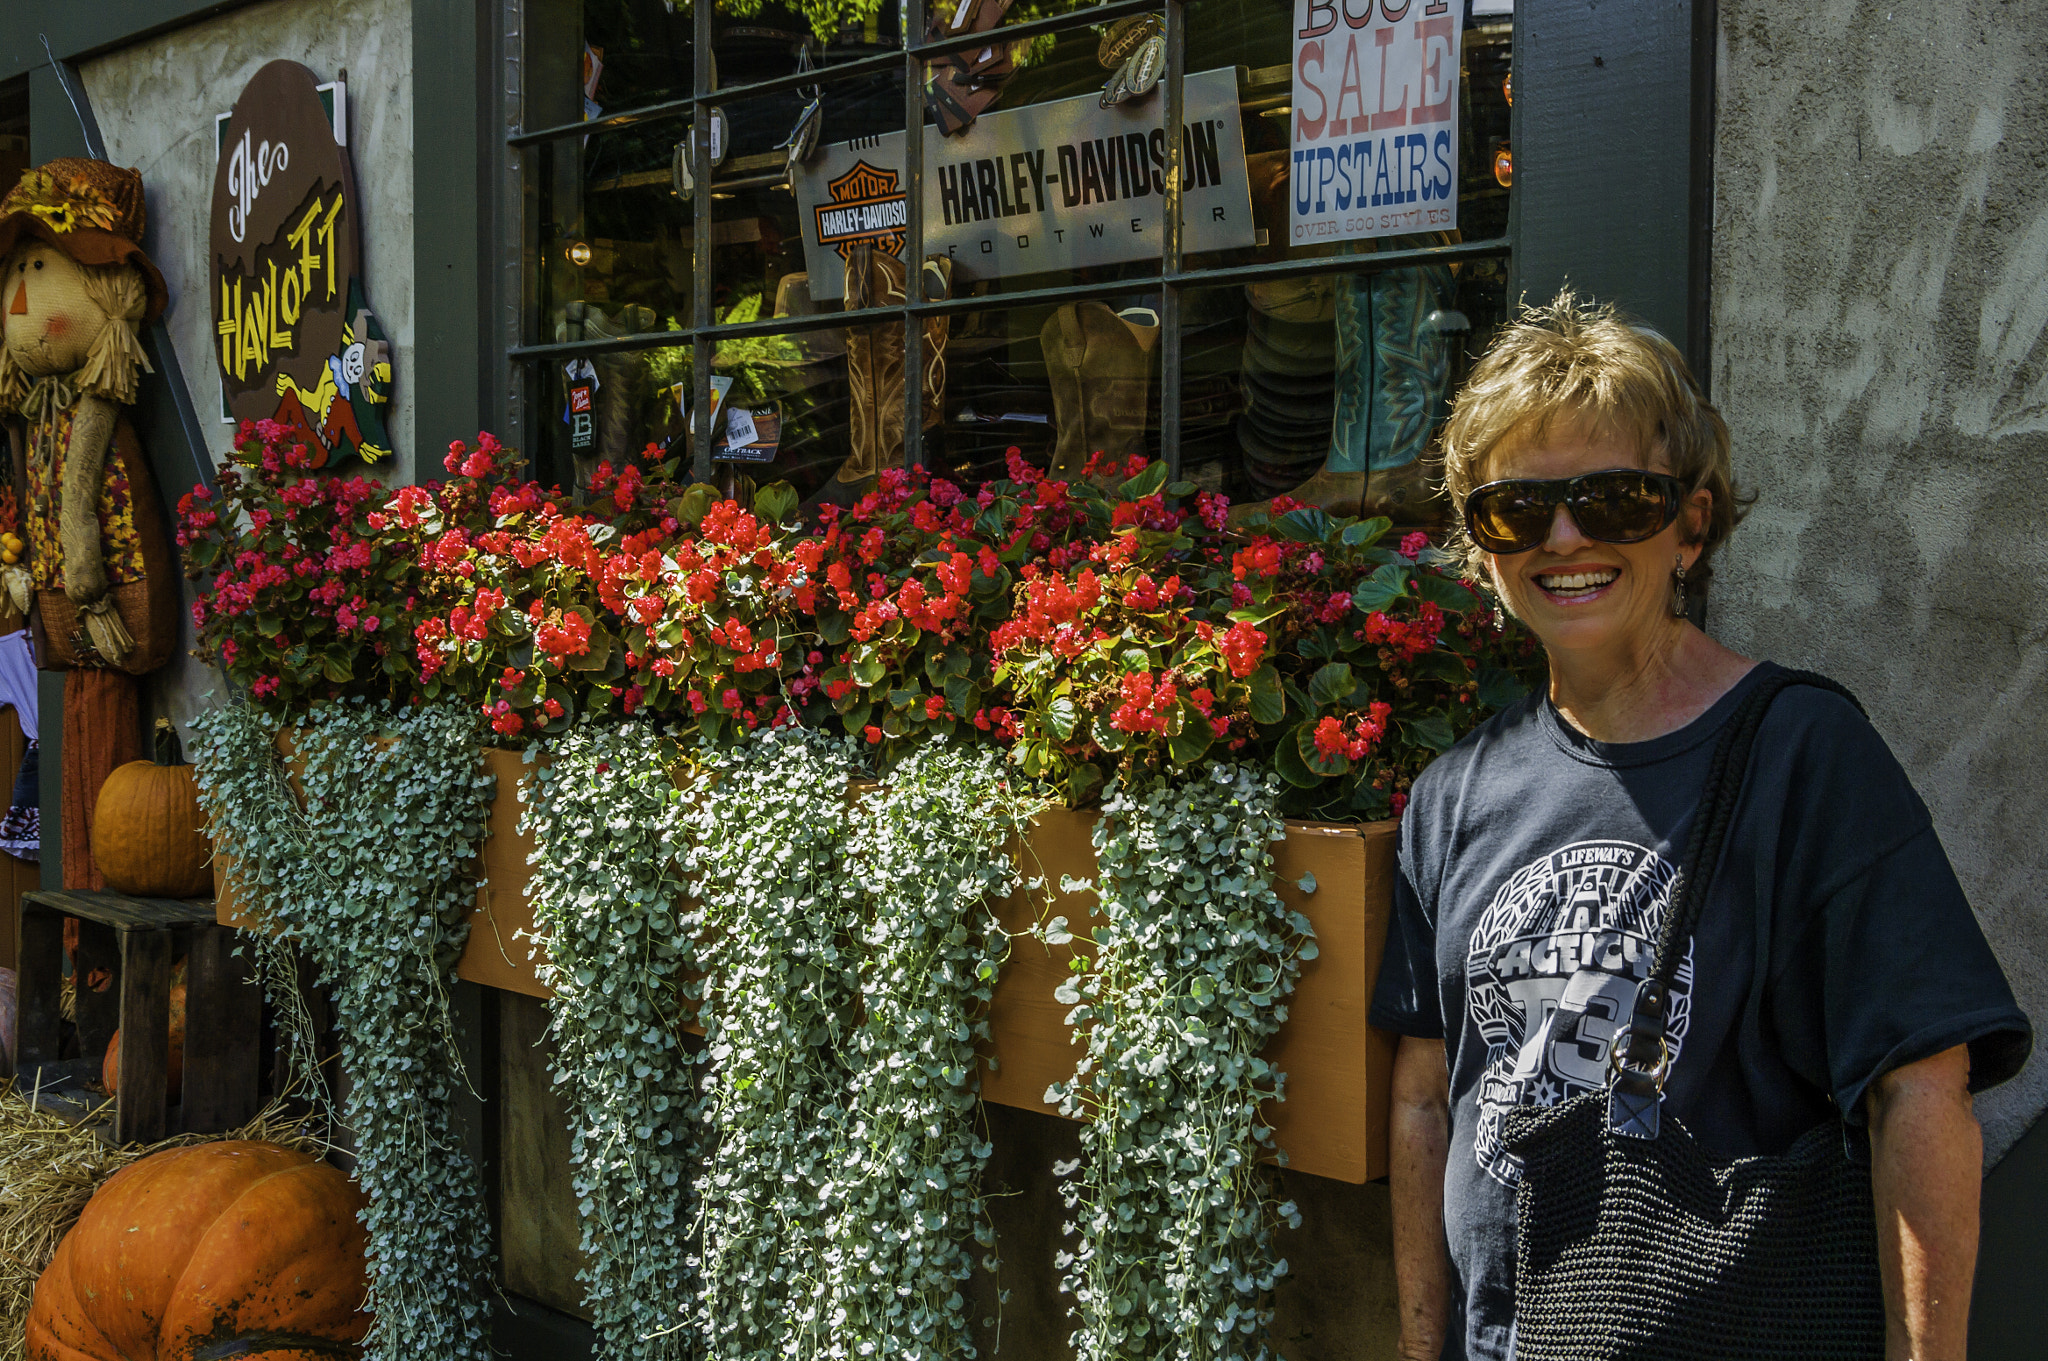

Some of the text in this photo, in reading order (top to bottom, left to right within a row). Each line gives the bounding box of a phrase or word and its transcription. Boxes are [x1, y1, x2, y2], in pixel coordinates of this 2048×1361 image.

[1298, 0, 1448, 39] BO
[1297, 16, 1455, 142] SALE
[228, 127, 289, 243] The
[840, 171, 889, 201] MOTOR
[938, 119, 1221, 226] HARLEY-DAVIDSON
[1294, 130, 1452, 216] UPSTAIRS
[821, 200, 906, 236] HARLEY-DAVIDSO
[948, 206, 1227, 258] FOOTWER
[1295, 208, 1451, 239] OVER 500 STYLES
[218, 193, 343, 382] HAYLOFT
[1561, 846, 1636, 868] LIFEWAY'S
